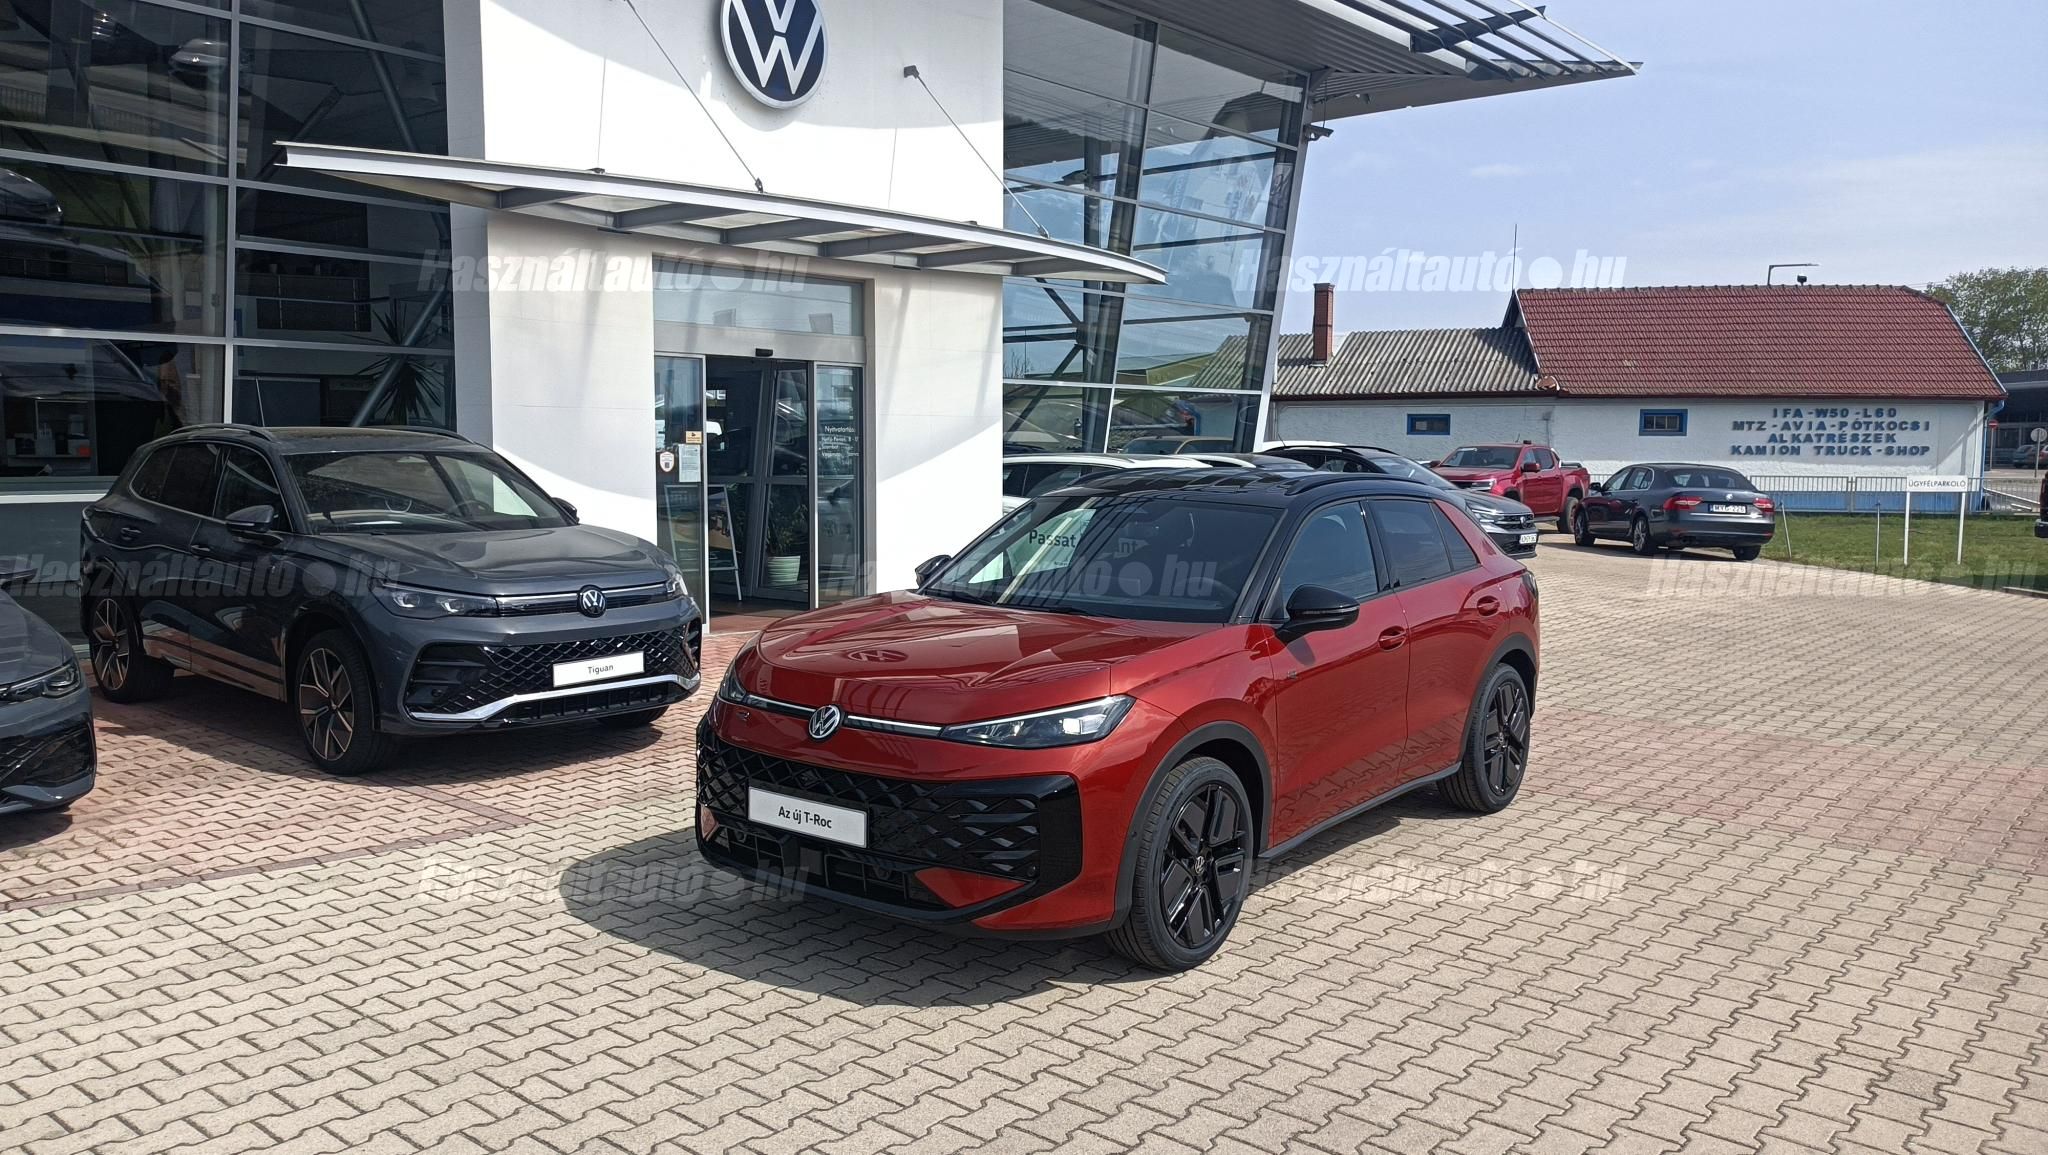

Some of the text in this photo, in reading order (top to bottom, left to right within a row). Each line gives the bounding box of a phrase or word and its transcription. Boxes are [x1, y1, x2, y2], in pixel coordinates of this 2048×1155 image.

[1767, 431, 1897, 443] ALKATRÉSZEK
[1730, 445, 1801, 456] KAMION
[587, 664, 614, 675] Tiguan
[778, 805, 832, 829] Az új T-Roc
